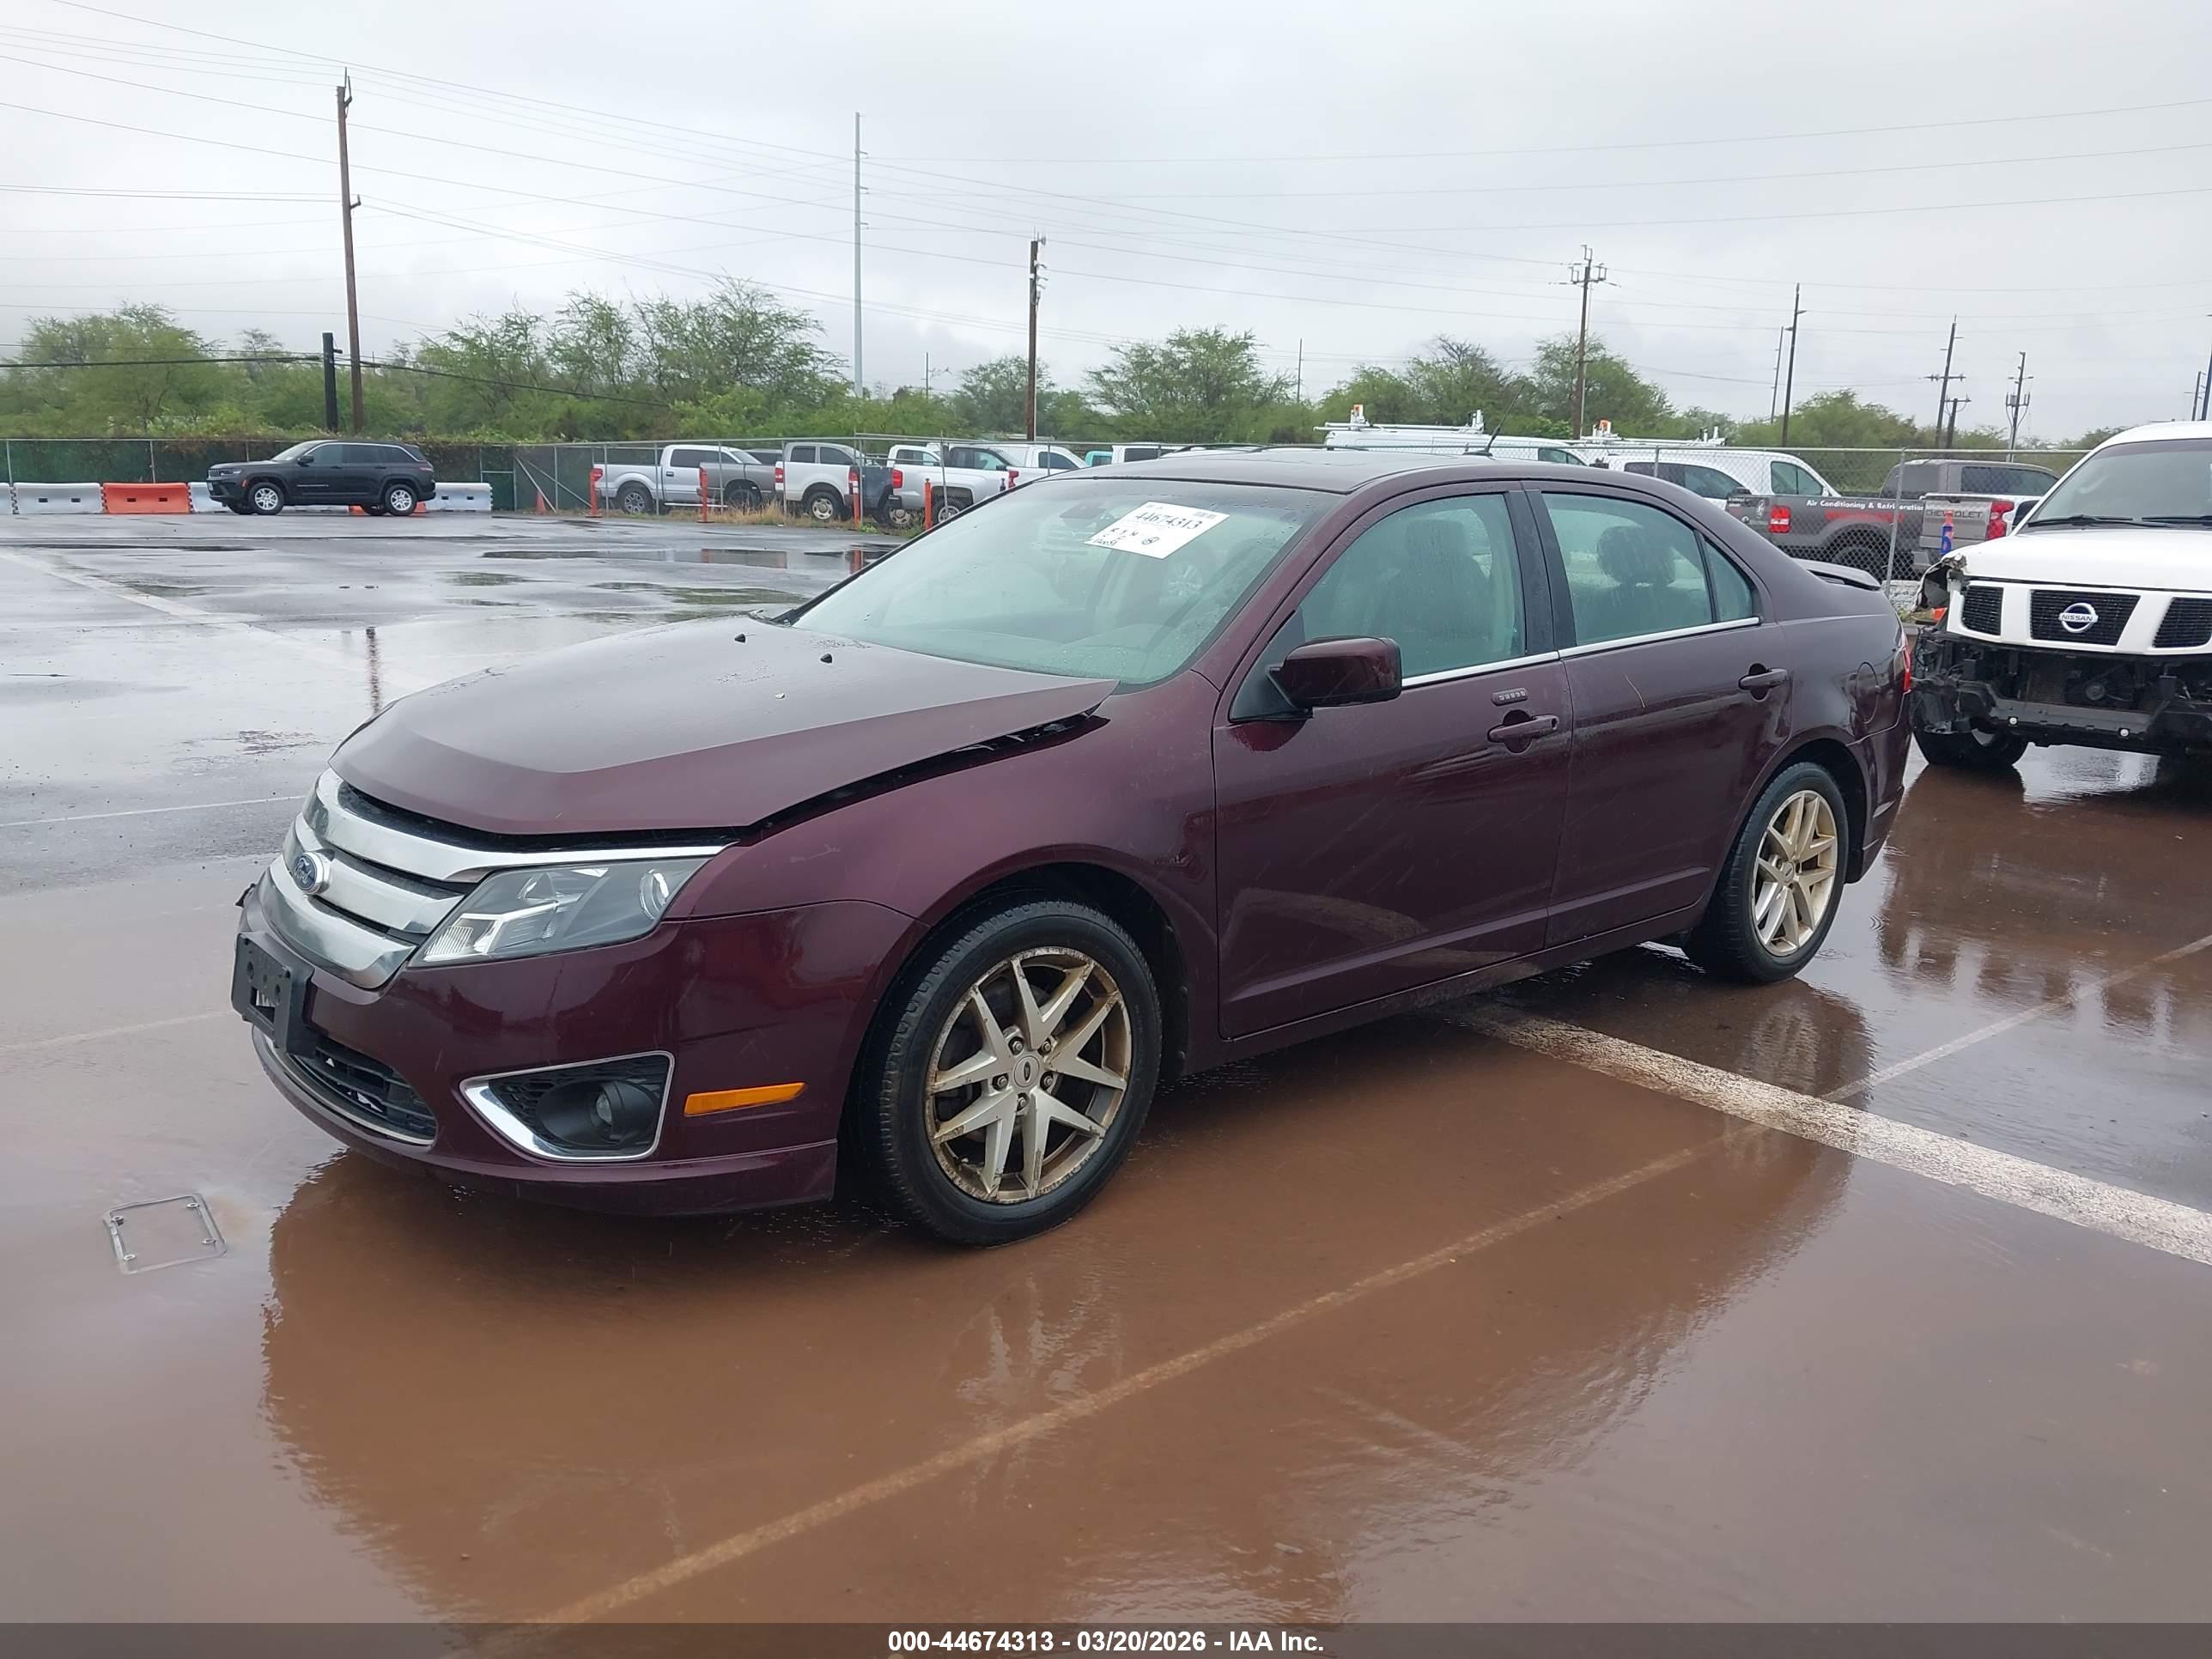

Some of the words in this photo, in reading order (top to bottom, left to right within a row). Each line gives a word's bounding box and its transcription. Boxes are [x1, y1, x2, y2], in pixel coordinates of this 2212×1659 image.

[1820, 501, 1865, 509] Conditioning
[1877, 502, 1923, 511] Refrieration
[1135, 512, 1202, 529] 44674313
[294, 857, 313, 885] Ford
